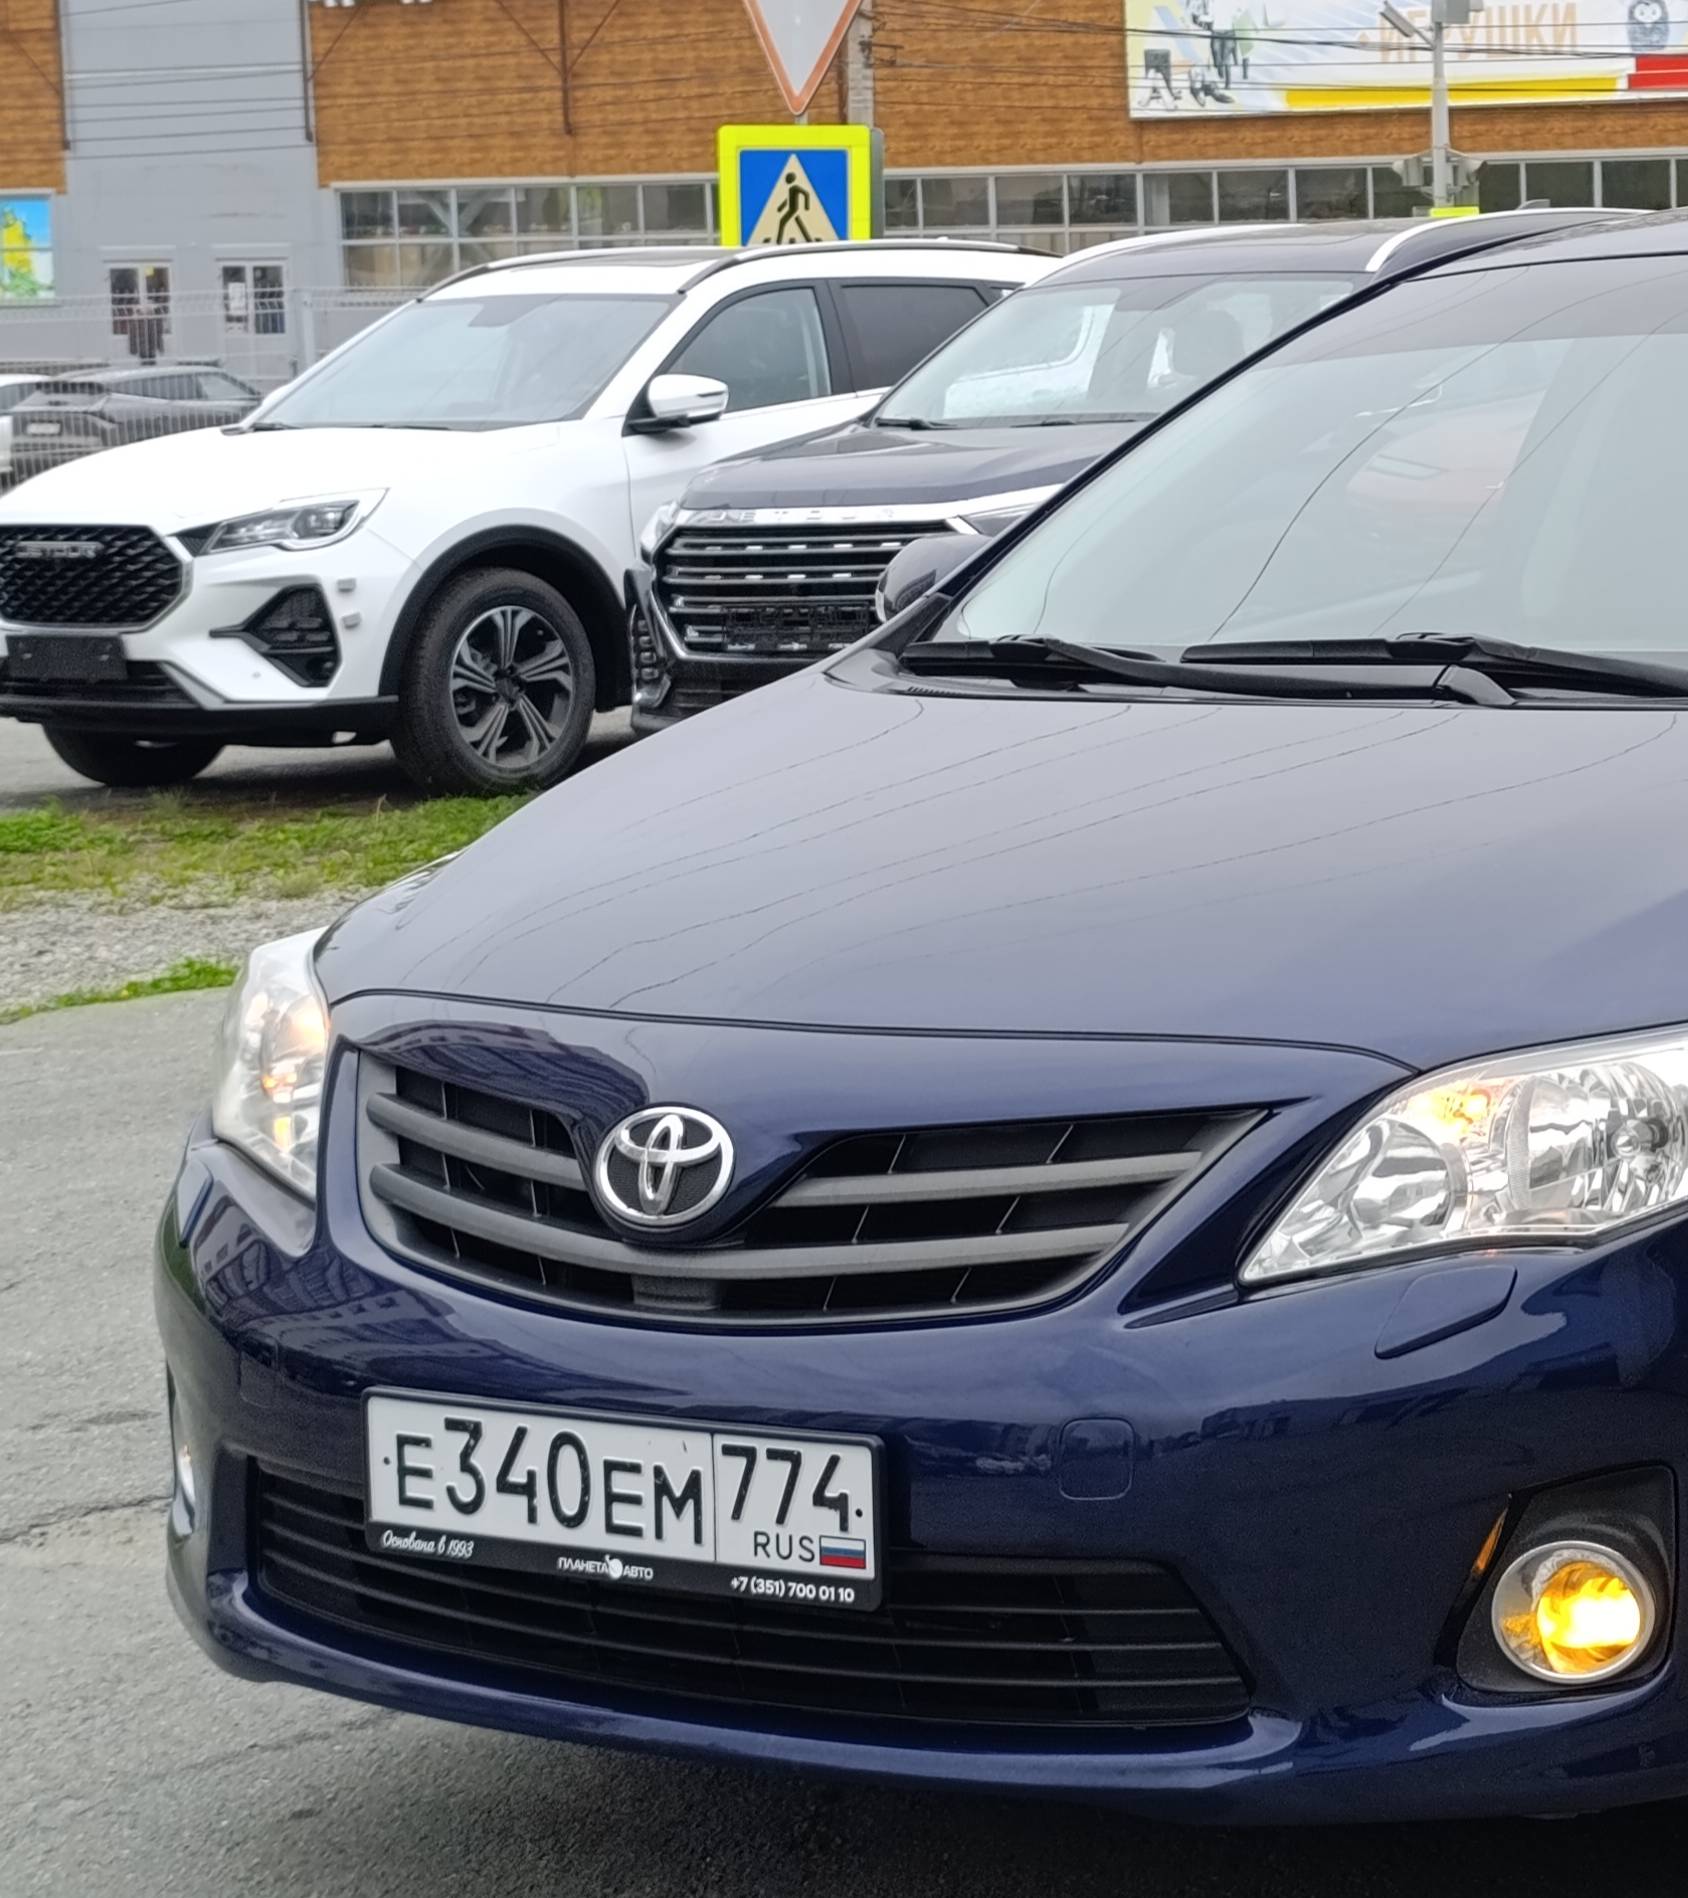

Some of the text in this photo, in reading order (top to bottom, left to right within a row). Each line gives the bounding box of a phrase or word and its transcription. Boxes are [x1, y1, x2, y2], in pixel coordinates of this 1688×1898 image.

[1378, 3, 1578, 62] ИГУШКИ
[396, 1417, 850, 1545] Е340ЕМ 774
[382, 1529, 436, 1554] Основана
[447, 1539, 475, 1559] 1993
[753, 1530, 816, 1563] RUS
[557, 1556, 654, 1581] ПЛАНЕТА АВТО
[731, 1575, 855, 1604] +7 (351) 700 01 10
